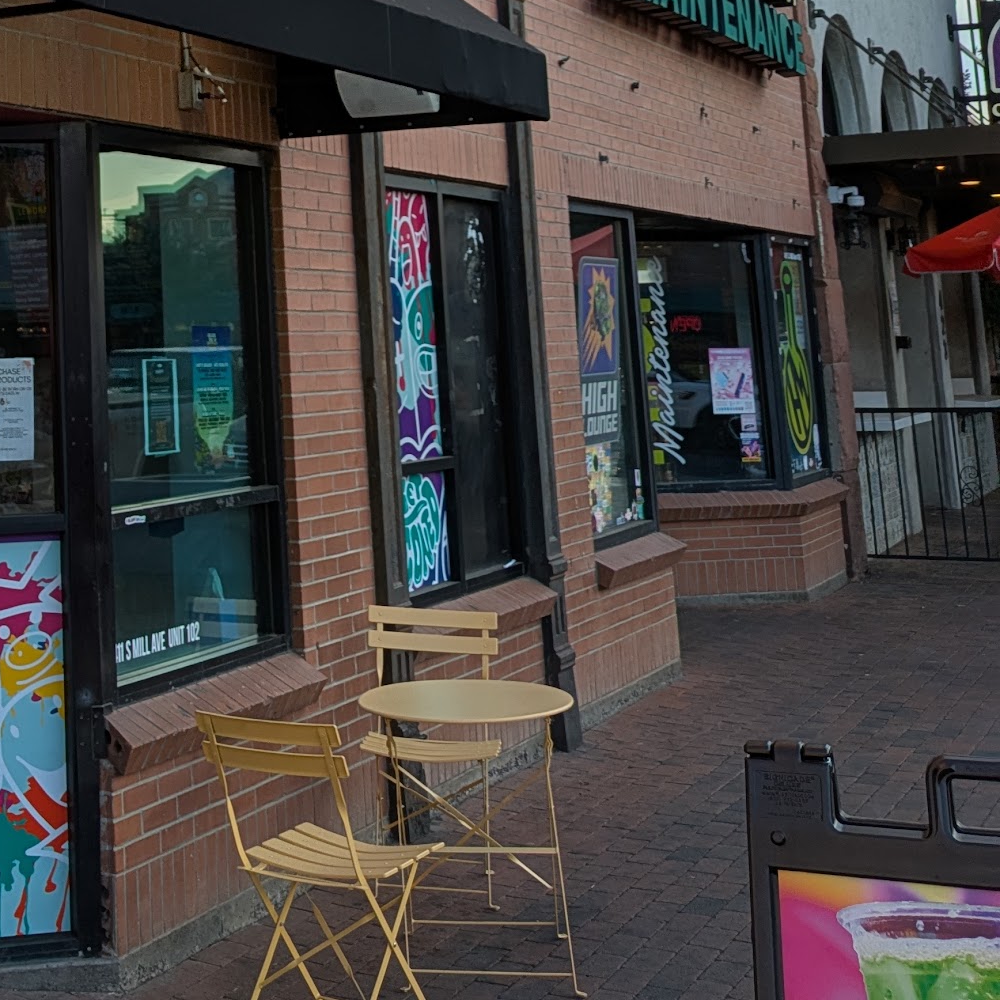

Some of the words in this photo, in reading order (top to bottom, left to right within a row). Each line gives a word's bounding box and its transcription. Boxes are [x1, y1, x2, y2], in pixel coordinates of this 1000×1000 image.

[581, 379, 618, 414] HIGH
[114, 643, 125, 664] 11
[125, 638, 132, 661] S
[132, 634, 152, 660] MILL
[151, 630, 167, 654] AVE
[167, 625, 185, 648] UNIT
[186, 621, 200, 641] 102
